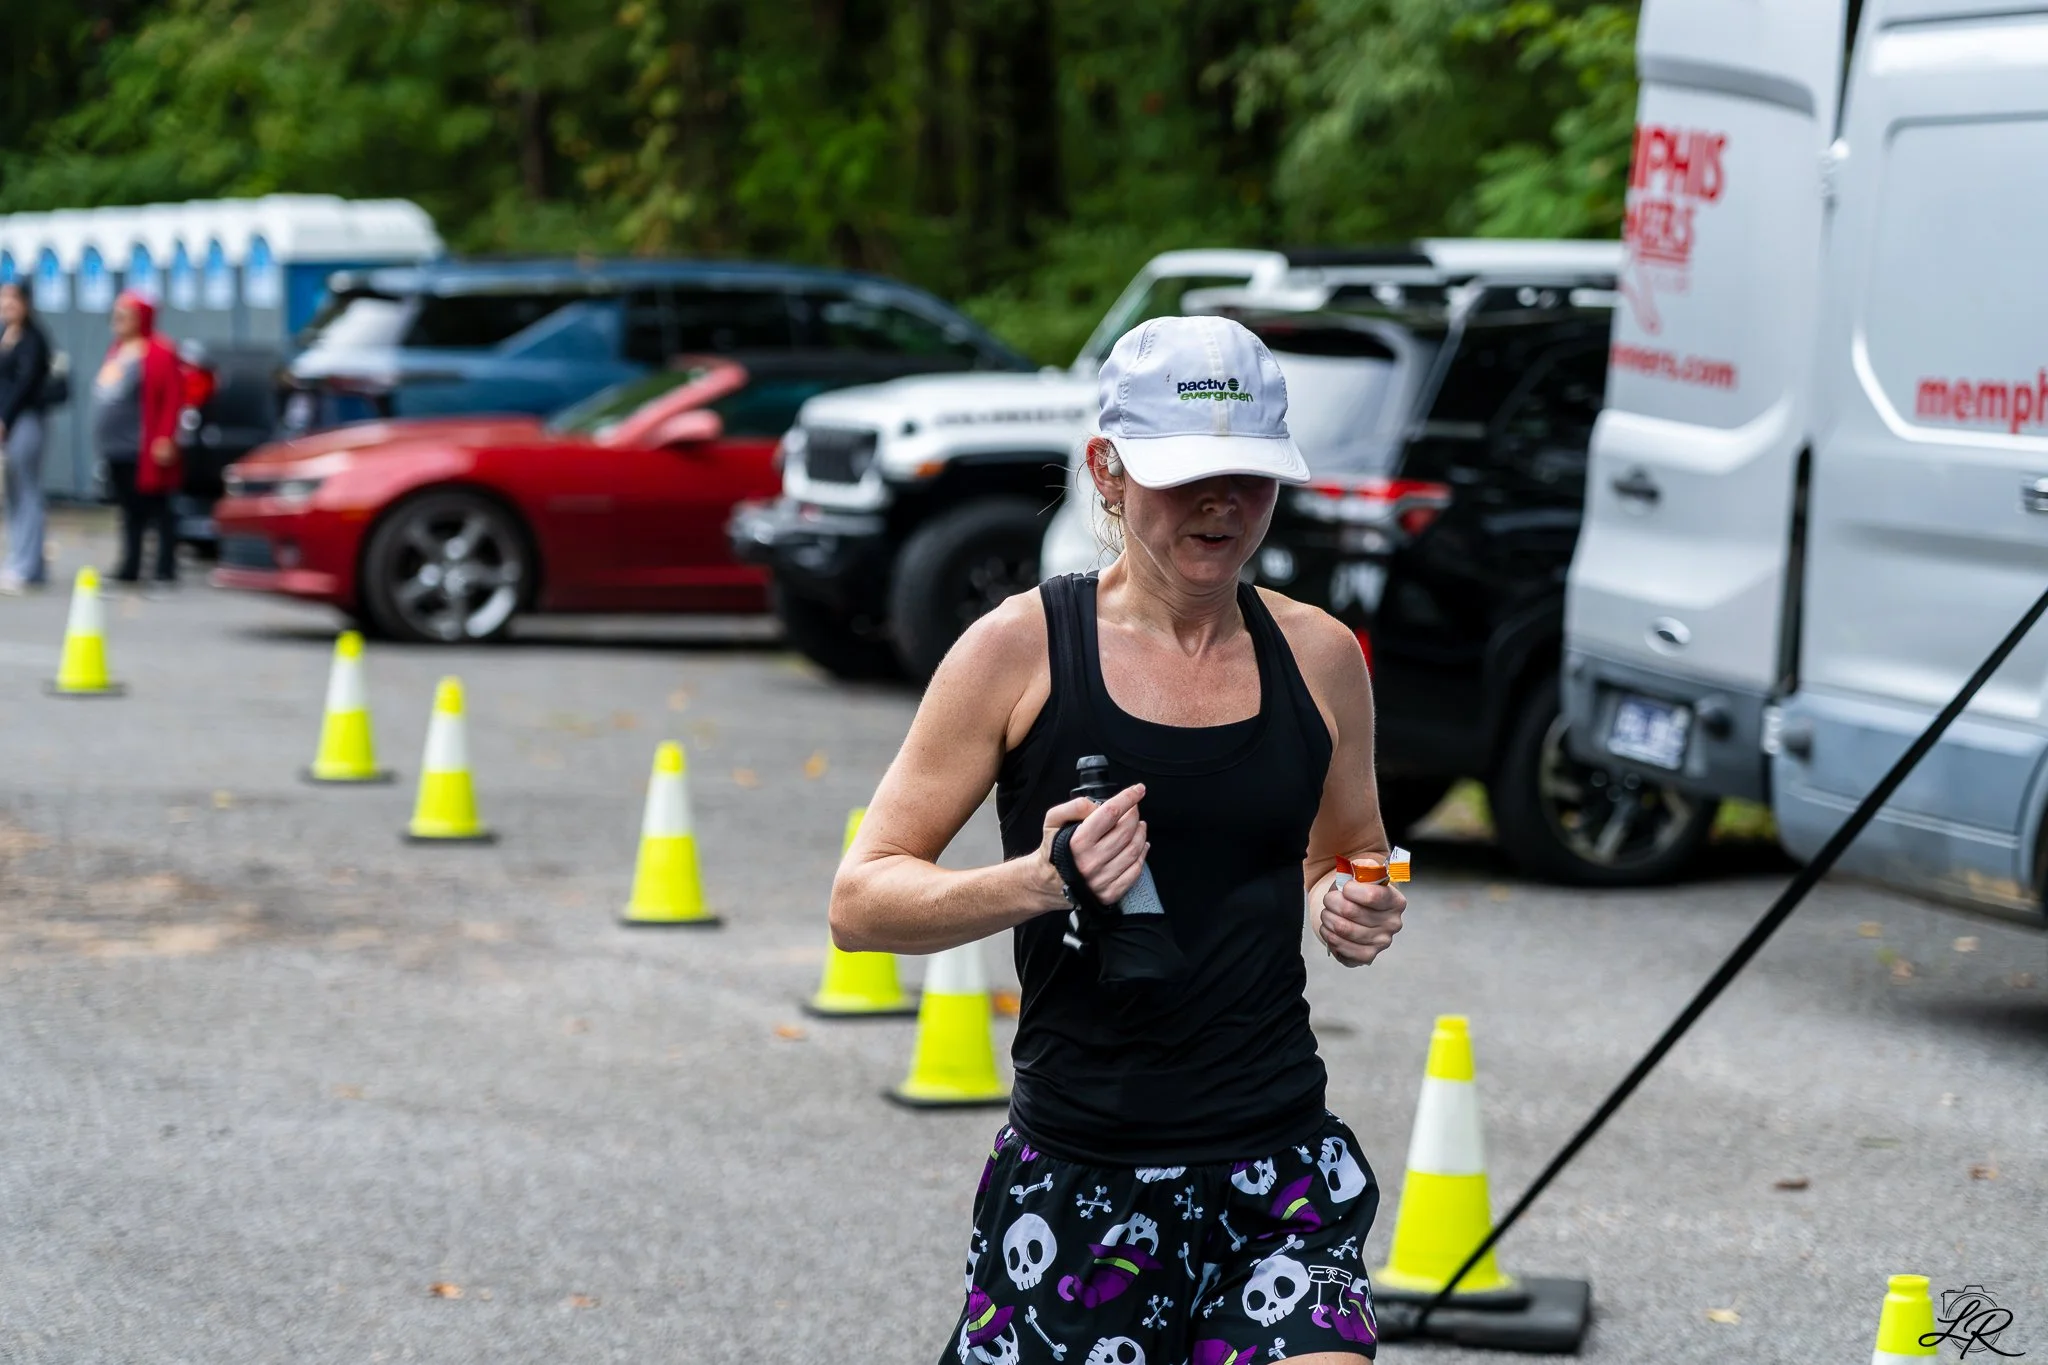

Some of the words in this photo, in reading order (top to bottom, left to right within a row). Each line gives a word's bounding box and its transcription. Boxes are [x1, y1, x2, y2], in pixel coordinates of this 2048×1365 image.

[1631, 124, 1728, 203] PHIS
[1177, 379, 1226, 394] pactiv
[1180, 391, 1254, 402] evergreen
